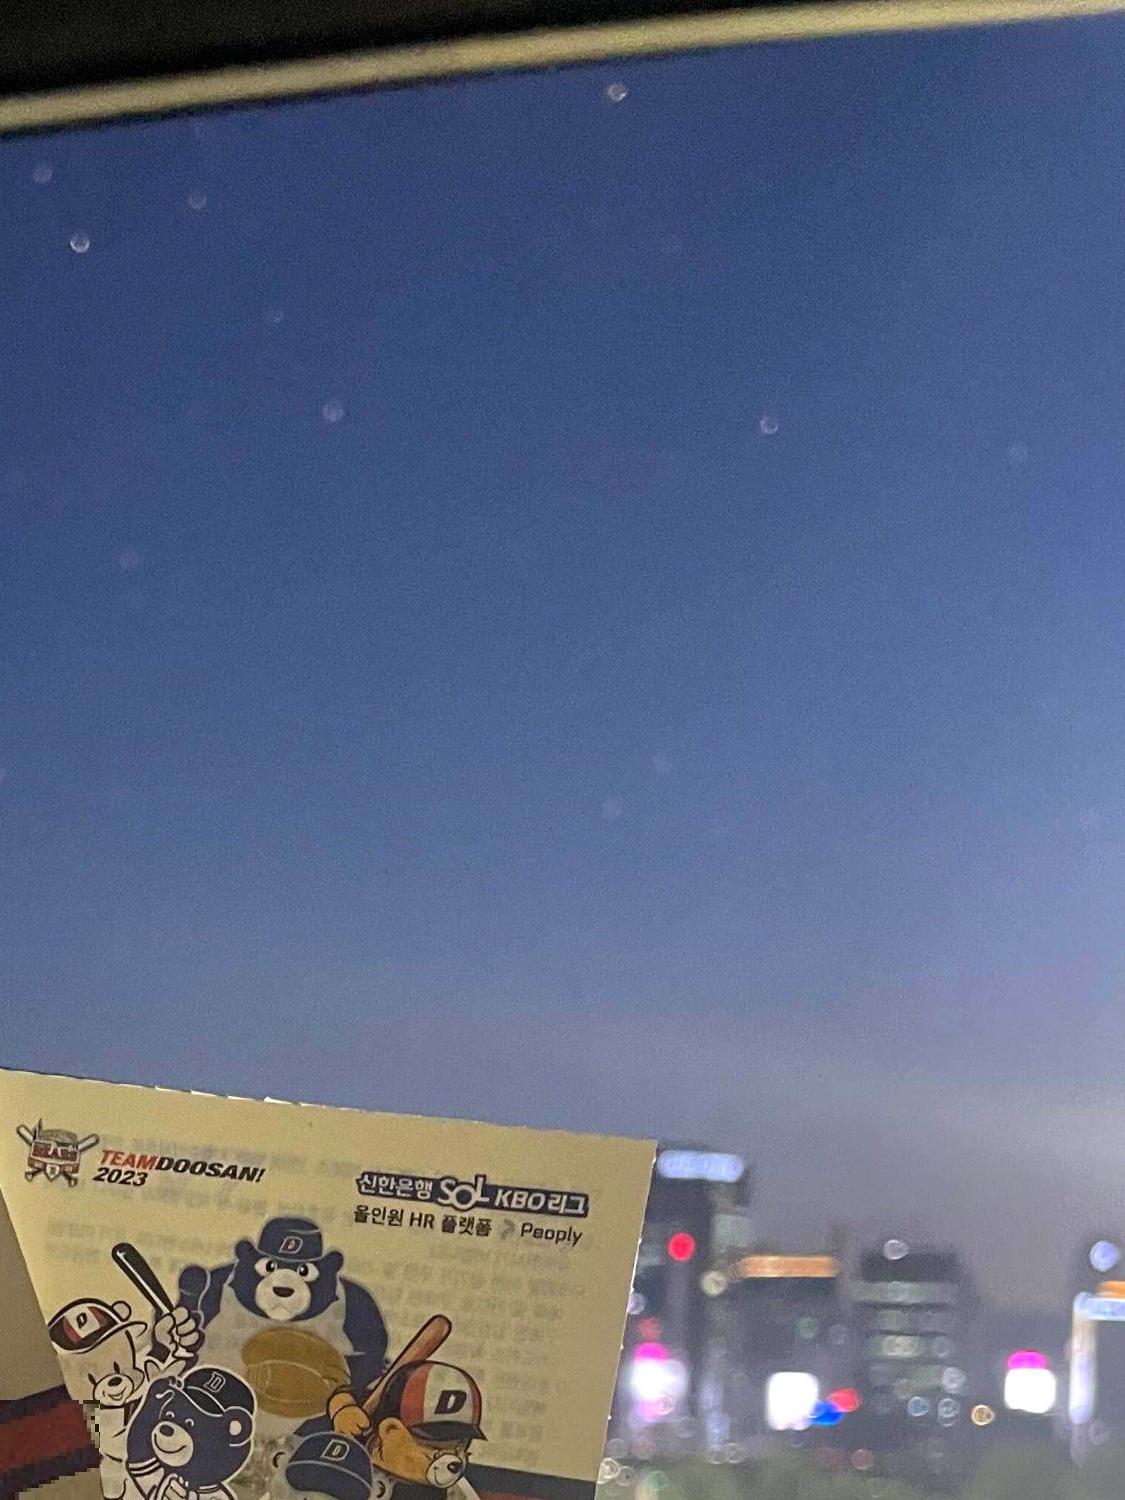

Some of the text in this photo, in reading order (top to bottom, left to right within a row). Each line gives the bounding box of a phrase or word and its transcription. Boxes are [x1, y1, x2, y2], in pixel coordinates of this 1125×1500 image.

[93, 1168, 148, 1187] 2023
[359, 1174, 434, 1200] 신한은행
[353, 1204, 404, 1227] 올인원
[409, 1212, 435, 1229] HR
[441, 1214, 492, 1237] 플랫폼
[278, 1236, 304, 1255] D
[204, 1372, 224, 1392] D
[434, 1389, 468, 1415] D
[324, 1441, 349, 1462] D
